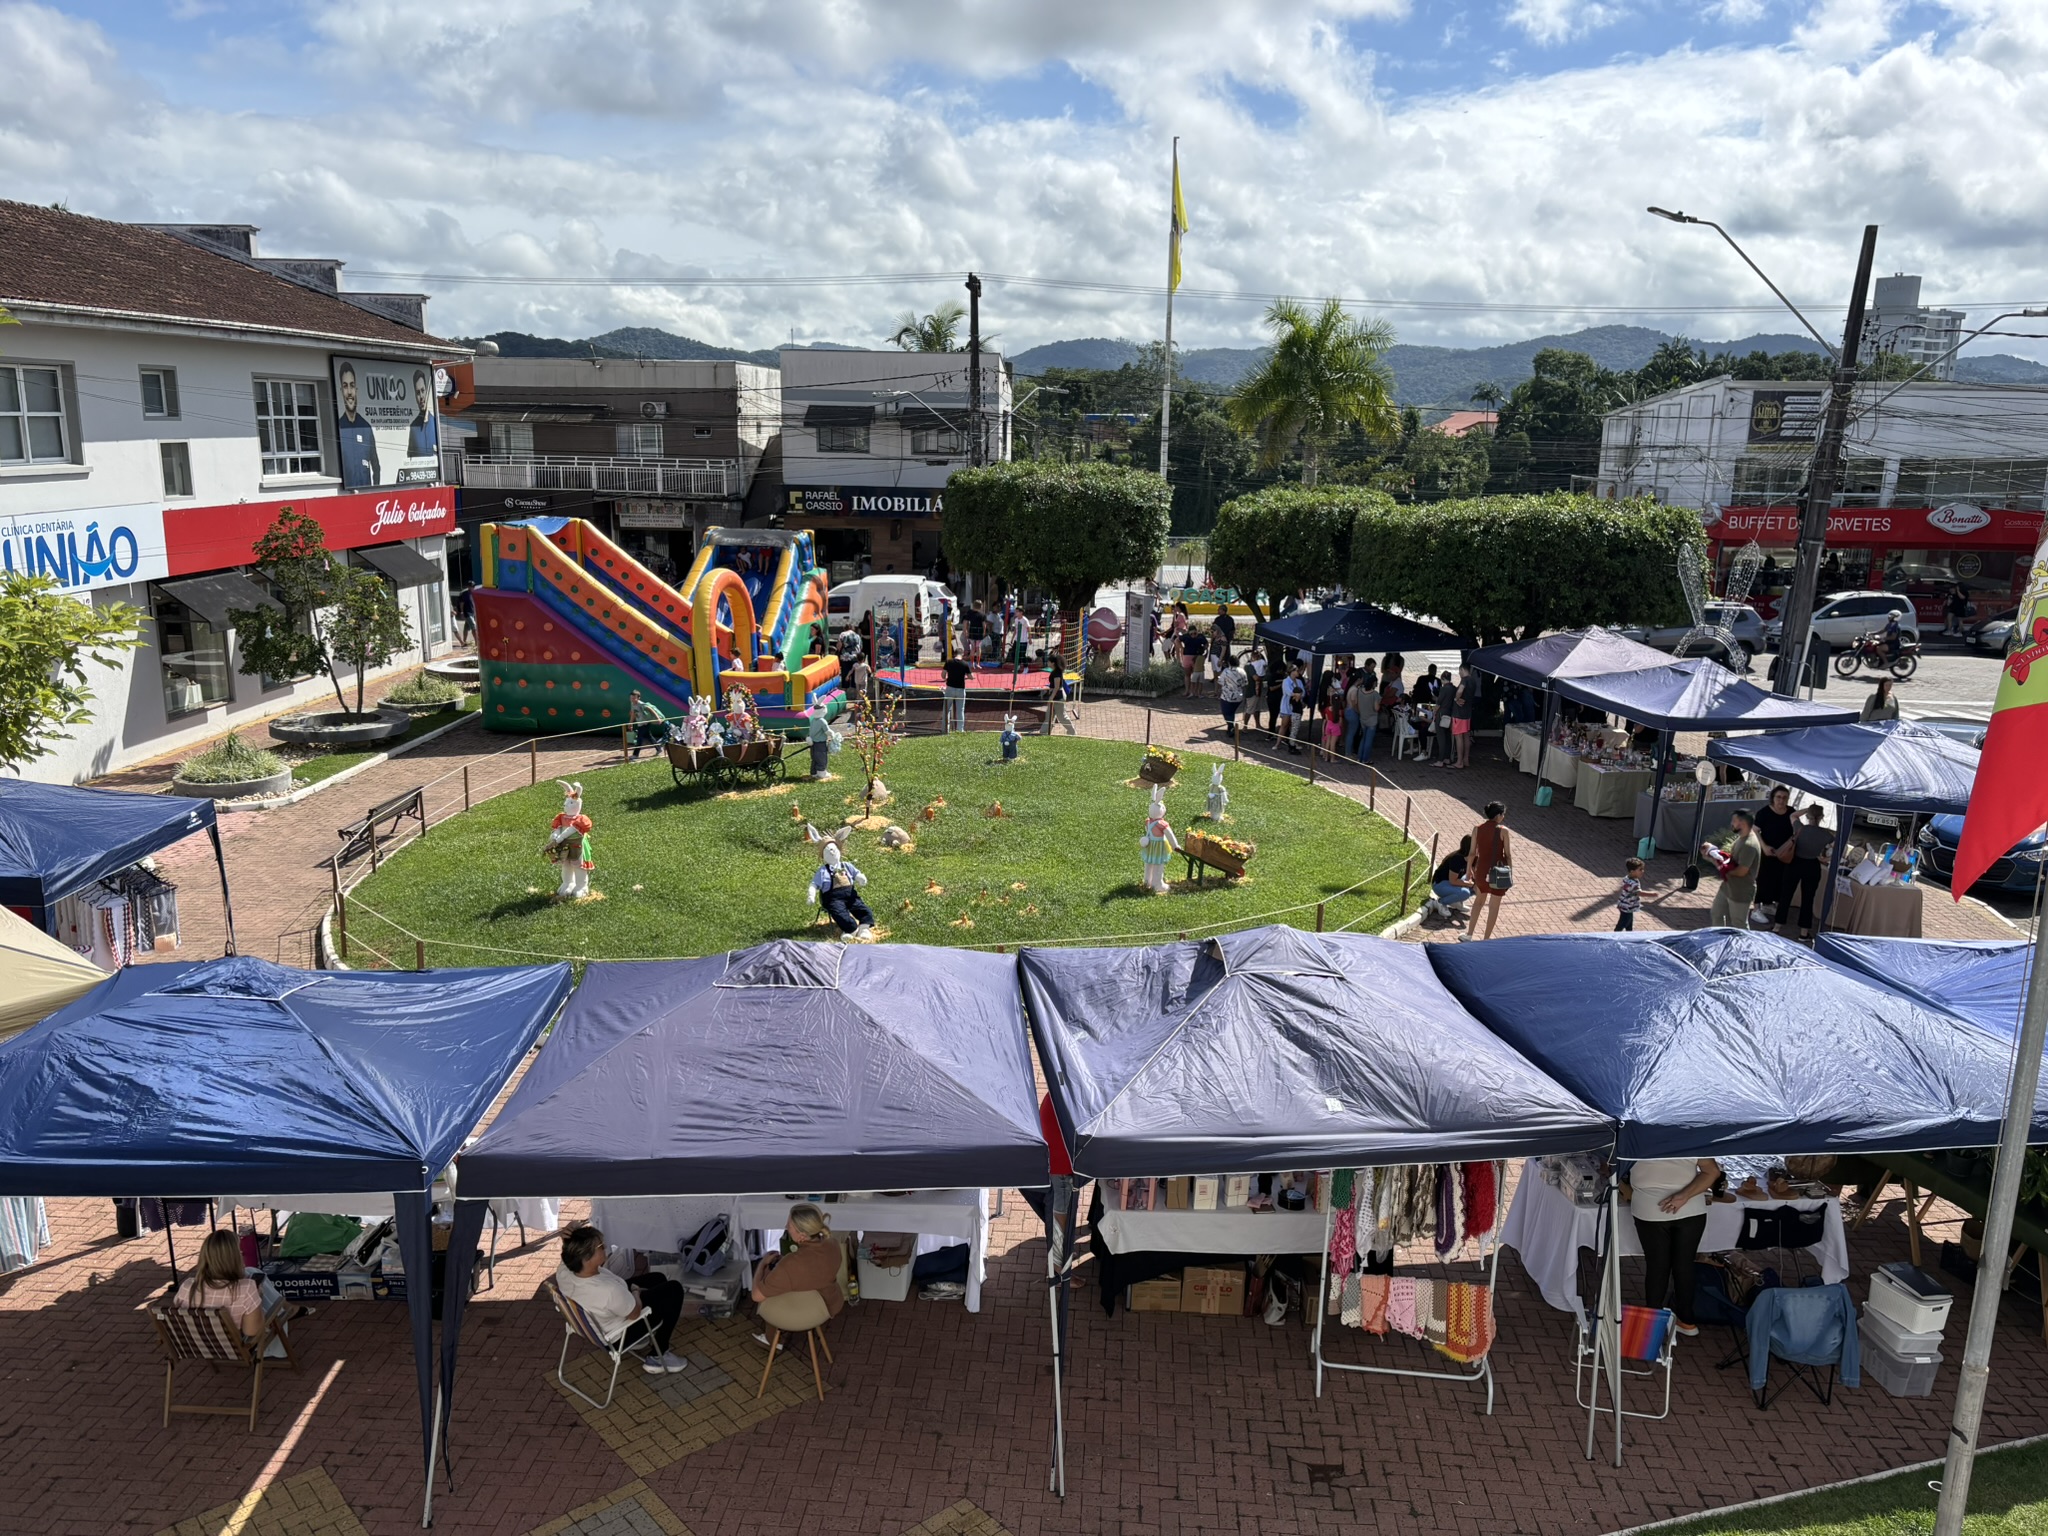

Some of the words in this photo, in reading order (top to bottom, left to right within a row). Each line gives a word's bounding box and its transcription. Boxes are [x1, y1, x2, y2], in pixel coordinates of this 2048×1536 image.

[366, 375, 406, 401] UNIÃO
[365, 407, 377, 416] SUA
[378, 405, 413, 416] REFERÊNCIA
[805, 491, 840, 500] RAFAEL
[805, 501, 843, 511] CASSIO
[370, 499, 405, 535] Julio
[408, 500, 447, 527] Calçados
[1728, 516, 1785, 530] BUFFET
[1826, 517, 1891, 531] ORVETES
[1937, 509, 1982, 524] Bonatti
[1, 523, 33, 537] CLÍNICA
[35, 519, 74, 534] DENTÁRIA
[3, 521, 139, 588] UNIÃO
[284, 1278, 334, 1287] DOBRÁVEL
